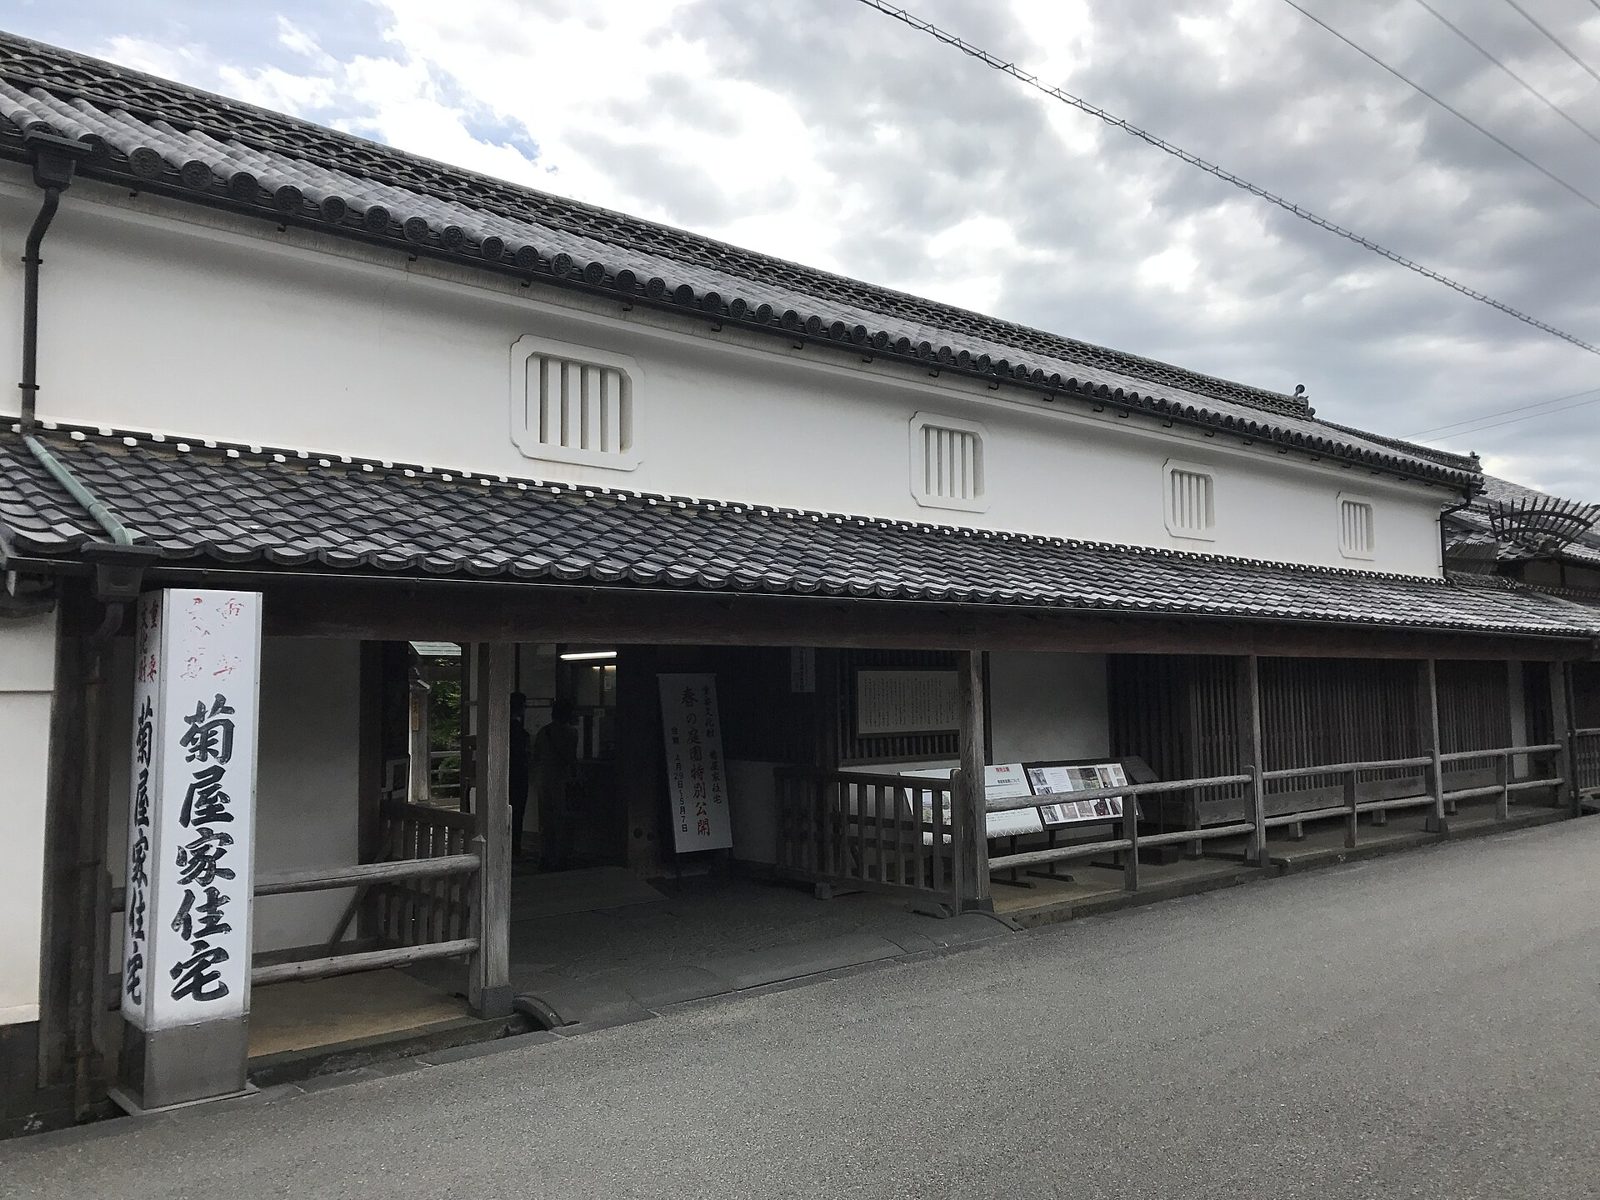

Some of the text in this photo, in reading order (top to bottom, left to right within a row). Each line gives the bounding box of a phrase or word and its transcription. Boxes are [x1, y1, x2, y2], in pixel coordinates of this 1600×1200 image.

[127, 696, 153, 1005] 菊屋家住宅
[170, 693, 236, 1001] 菊屋家住宅
